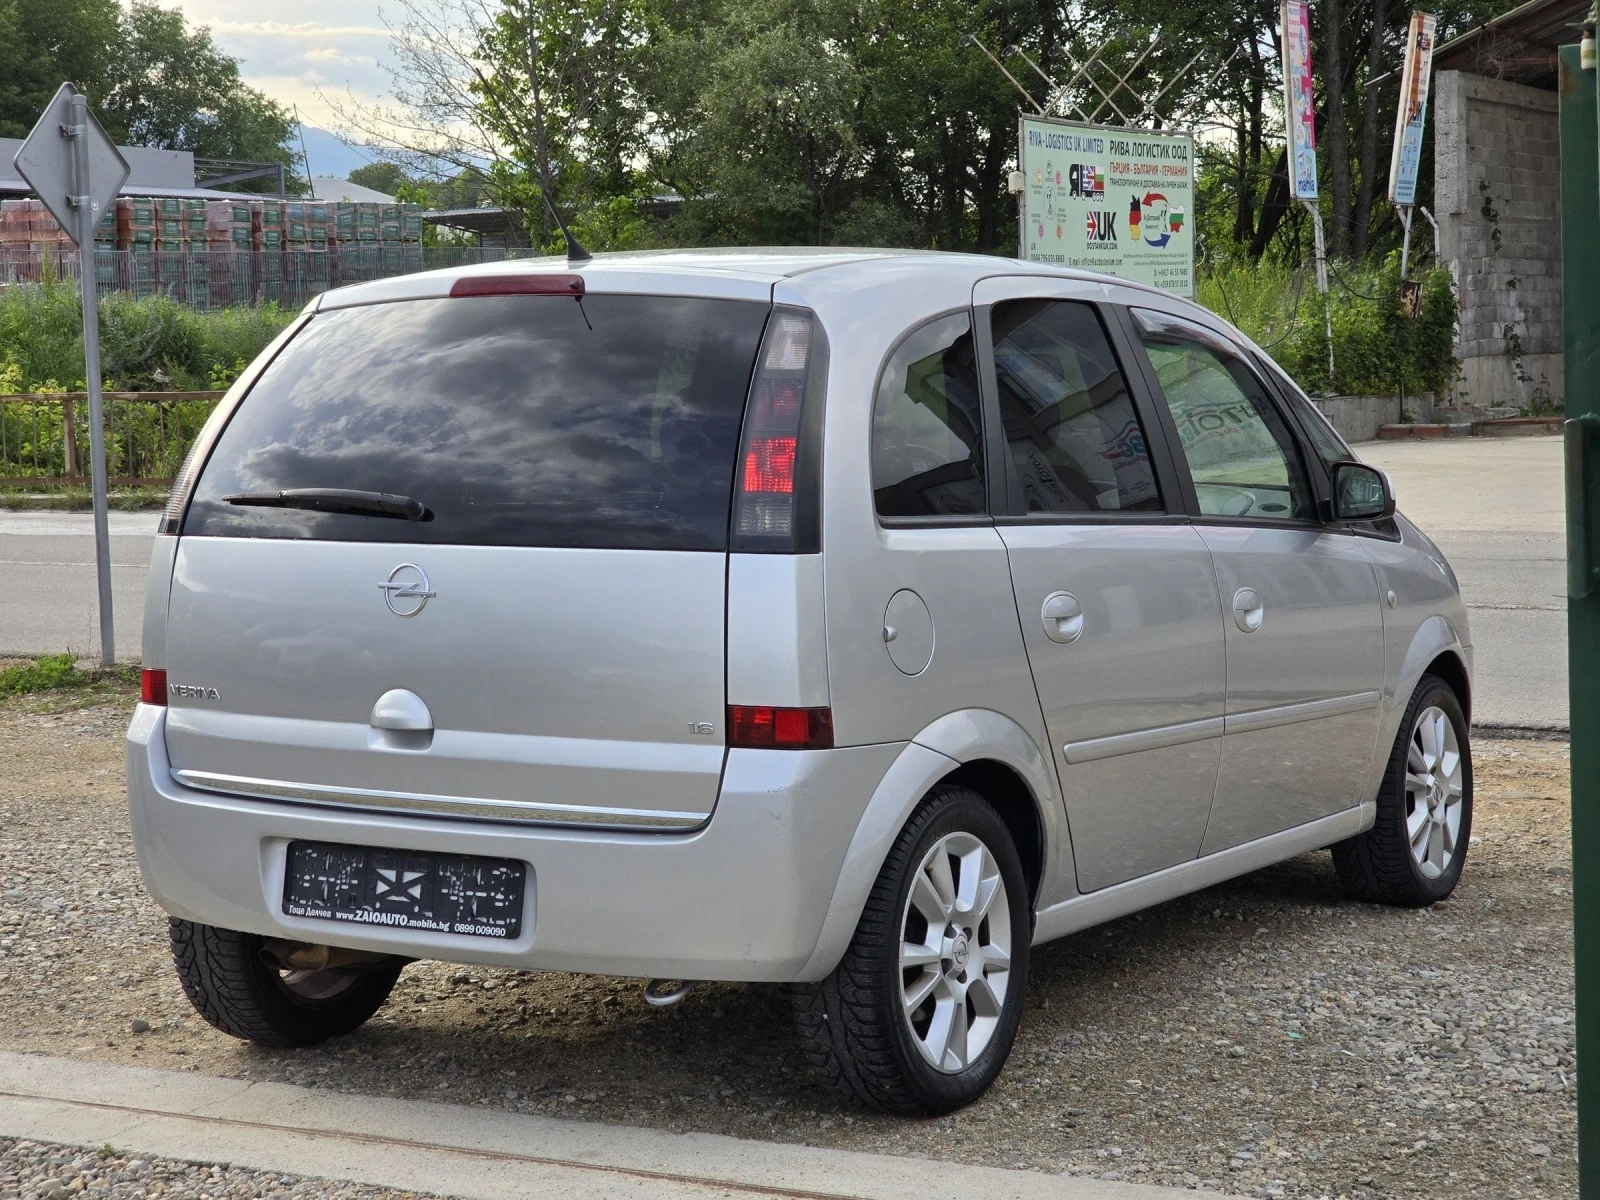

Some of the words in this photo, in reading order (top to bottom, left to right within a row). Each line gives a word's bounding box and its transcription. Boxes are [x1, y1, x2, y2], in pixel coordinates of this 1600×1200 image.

[1029, 130, 1042, 147] RIVA
[1046, 133, 1072, 151] LOGISTICS
[1074, 136, 1081, 151] UK
[1083, 137, 1104, 154] LIMITED
[1110, 140, 1130, 157] РИВА
[1132, 142, 1170, 159] ЛОГИСТИК
[1171, 145, 1187, 163] ООД
[1110, 162, 1130, 175] ГЪРЦИЯ
[1133, 163, 1158, 175] БЪЛГАРИЯ
[1162, 165, 1187, 177] ГЕРМАНИЯ
[1097, 211, 1118, 241] UK
[170, 684, 222, 700] MERIVA
[289, 904, 305, 916] Гоце
[306, 906, 332, 919] Делчев
[335, 909, 450, 931] www.ZAIOAUTO.mobile.bg
[454, 923, 475, 934] 0899
[476, 925, 506, 937] 009090
